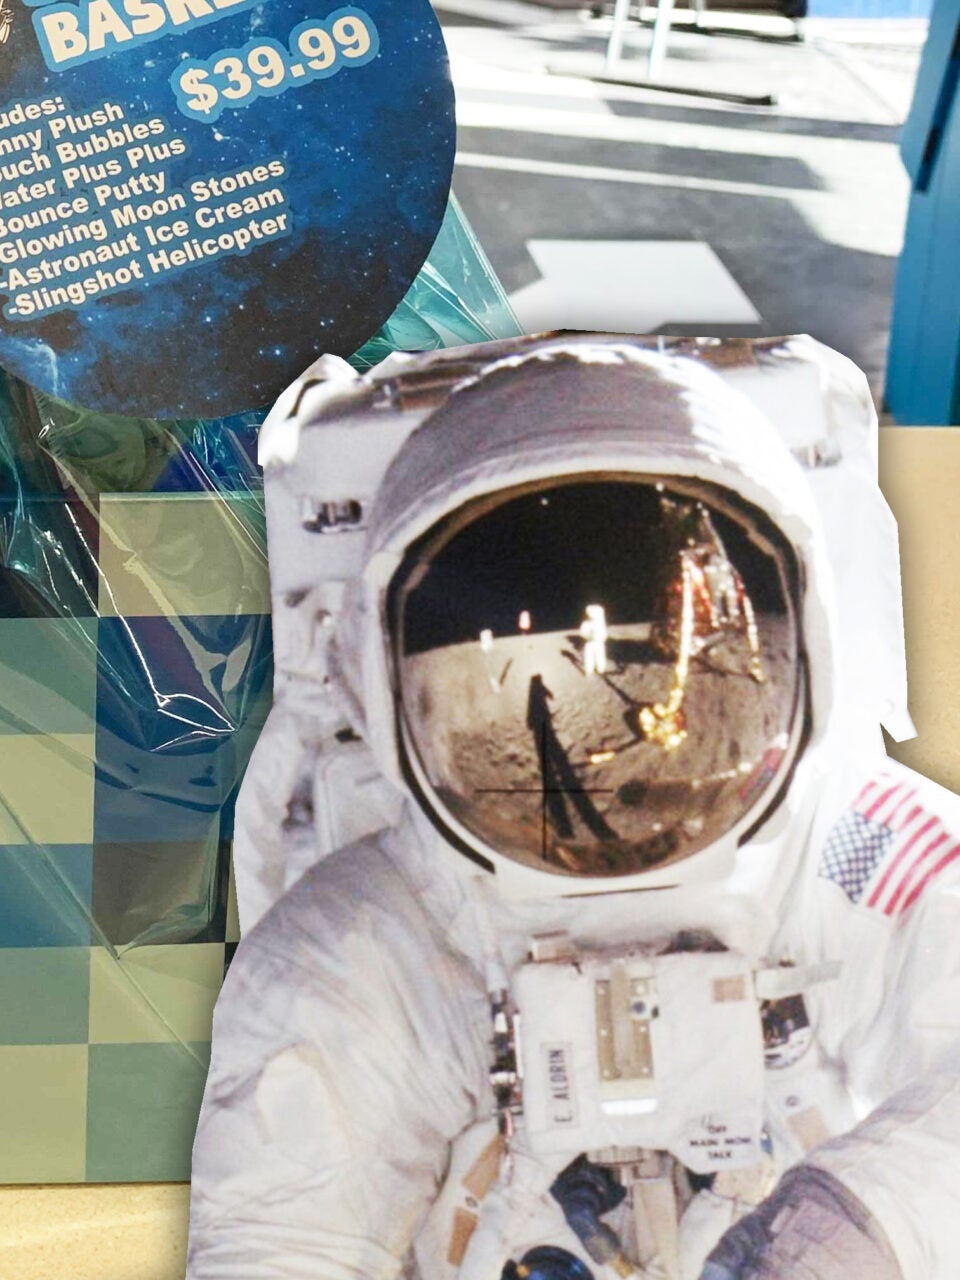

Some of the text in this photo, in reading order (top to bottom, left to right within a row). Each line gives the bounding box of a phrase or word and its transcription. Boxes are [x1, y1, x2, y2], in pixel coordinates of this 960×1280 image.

[179, 16, 371, 115] $39.99
[48, 102, 124, 140] Plush
[56, 117, 165, 164] Bubbles
[62, 156, 122, 189] Plus
[126, 137, 186, 169] Plus
[94, 171, 166, 207] Putty
[111, 192, 187, 229] Moon
[190, 160, 285, 203] Stones
[0, 187, 285, 291] -Astronaut Ice Cream
[8, 212, 288, 317] -Slingshot Helicopter
[549, 1049, 570, 1101] ALDRIN
